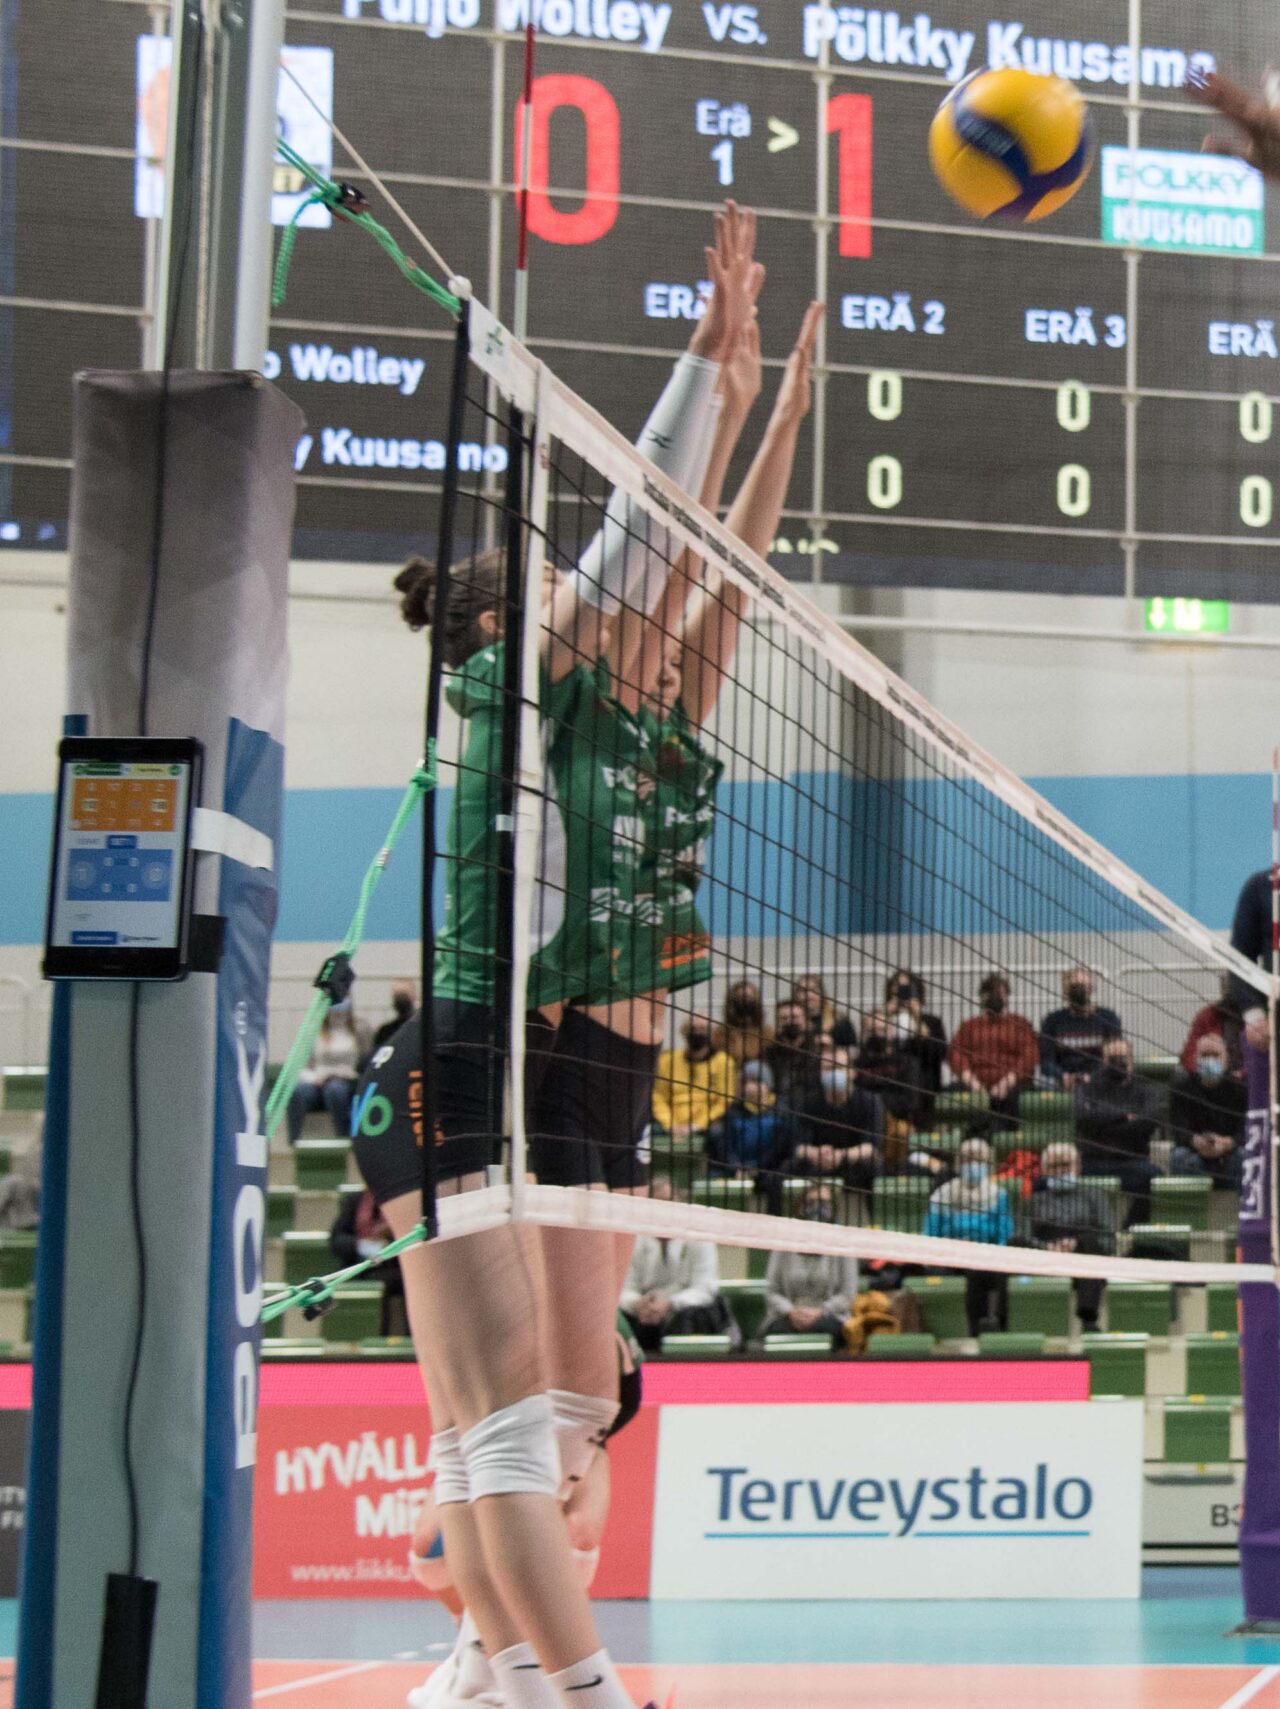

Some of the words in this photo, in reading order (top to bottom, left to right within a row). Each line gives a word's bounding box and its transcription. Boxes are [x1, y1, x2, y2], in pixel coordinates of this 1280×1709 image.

[499, 0, 671, 53] Wolley
[802, 4, 976, 83] Pölkky
[987, 20, 1217, 88] Kuusamo
[695, 100, 752, 138] Erä
[515, 73, 620, 245] 0
[711, 143, 735, 186] 1
[825, 93, 873, 259] 1
[840, 293, 916, 333] ERÄ
[922, 300, 946, 335] 2
[1023, 307, 1096, 347] ERÄ
[1104, 316, 1128, 350] 3
[1207, 318, 1278, 359] ERÄ
[290, 344, 425, 395] Wolley
[867, 370, 902, 422] 0
[1056, 380, 1092, 433] 0
[1239, 391, 1273, 443] 0
[321, 427, 508, 472] Kuusamo
[867, 456, 902, 509] 0
[1056, 464, 1092, 517] 0
[1239, 475, 1273, 527] 0
[706, 1463, 1094, 1538] Terveystalo
